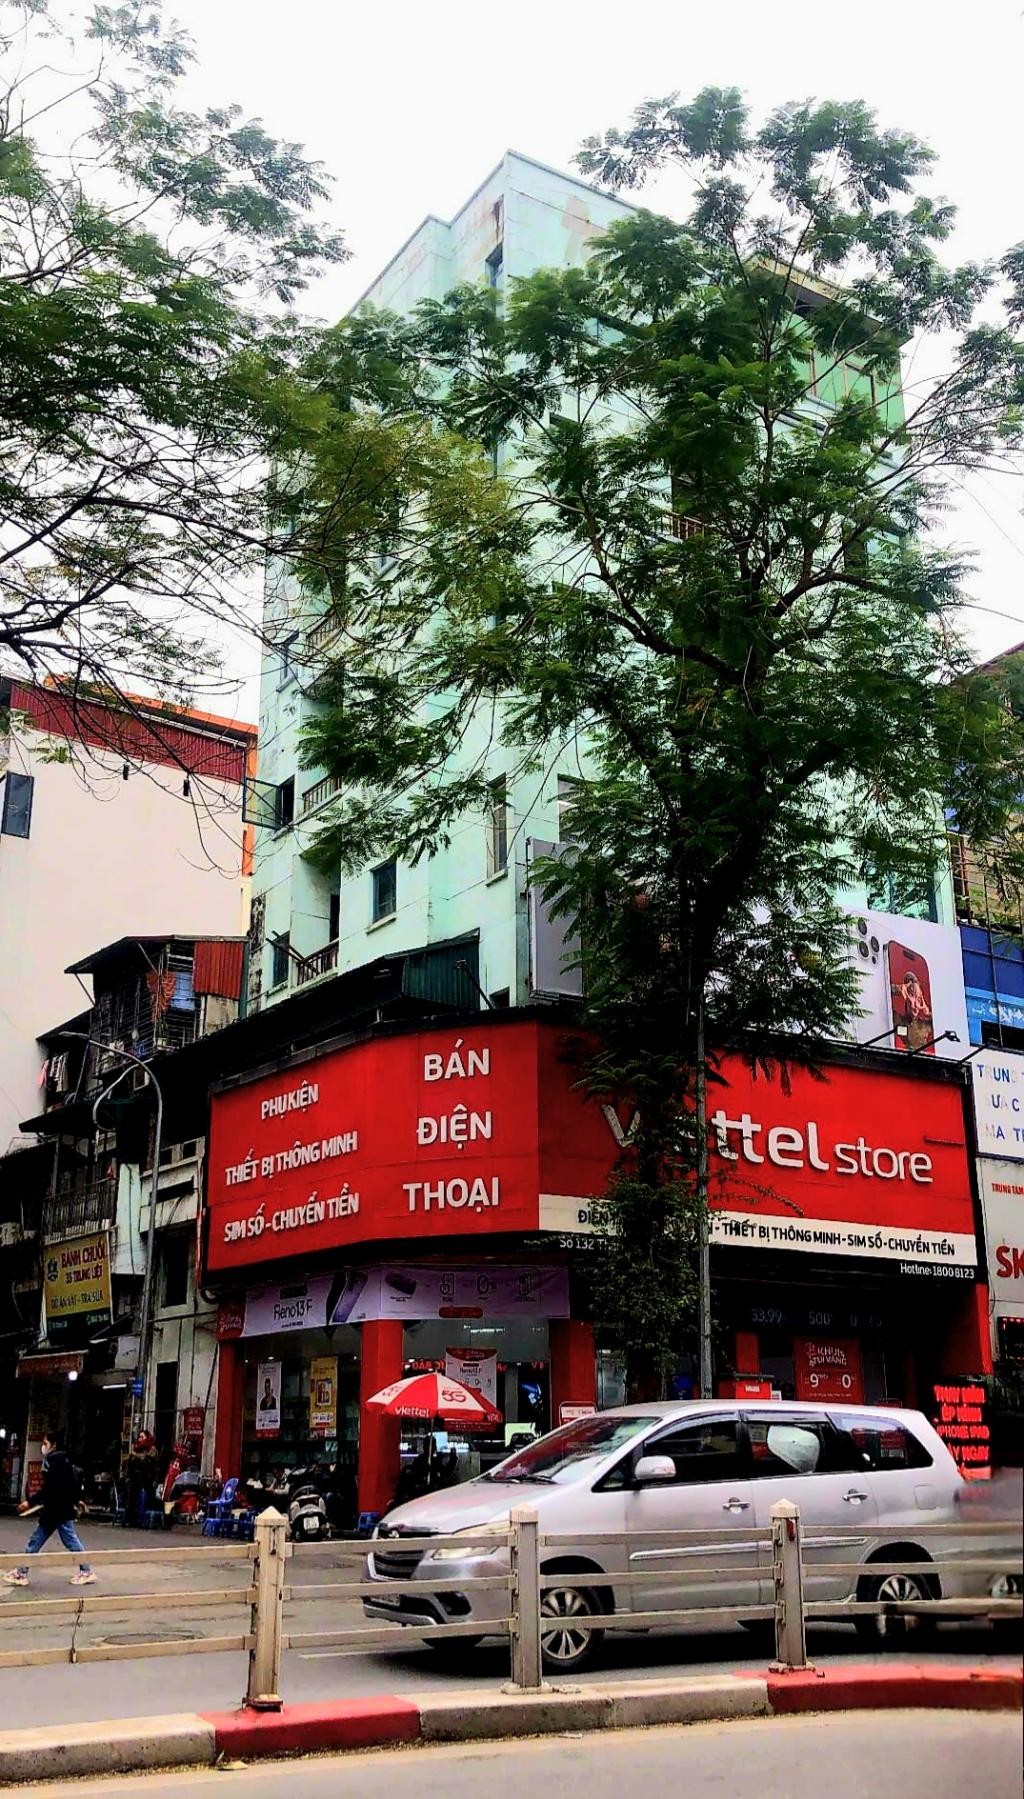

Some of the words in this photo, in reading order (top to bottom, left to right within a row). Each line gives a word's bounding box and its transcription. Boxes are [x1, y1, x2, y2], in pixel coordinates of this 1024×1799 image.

[424, 1038, 490, 1081] BÁN
[261, 1094, 288, 1120] PHỤ
[287, 1079, 319, 1113] KIỆN
[416, 1103, 492, 1150] ĐIỆN
[601, 1104, 830, 1171] vttel
[834, 1136, 934, 1182] store
[225, 1148, 260, 1186] THIẾT
[261, 1155, 274, 1179] BỊ
[275, 1140, 321, 1172] THÔNG
[321, 1130, 358, 1160] MINH
[224, 1220, 246, 1242] SIM
[327, 1182, 360, 1219] TIỀN
[402, 1176, 499, 1213] THOẠI
[575, 1238, 595, 1250] 132
[721, 1219, 757, 1238] THIẾT
[758, 1225, 770, 1242] BỊ
[771, 1225, 812, 1243] THÔNG
[813, 1230, 841, 1245] MINH
[847, 1234, 867, 1248] SIM
[394, 1405, 430, 1418] viettel
